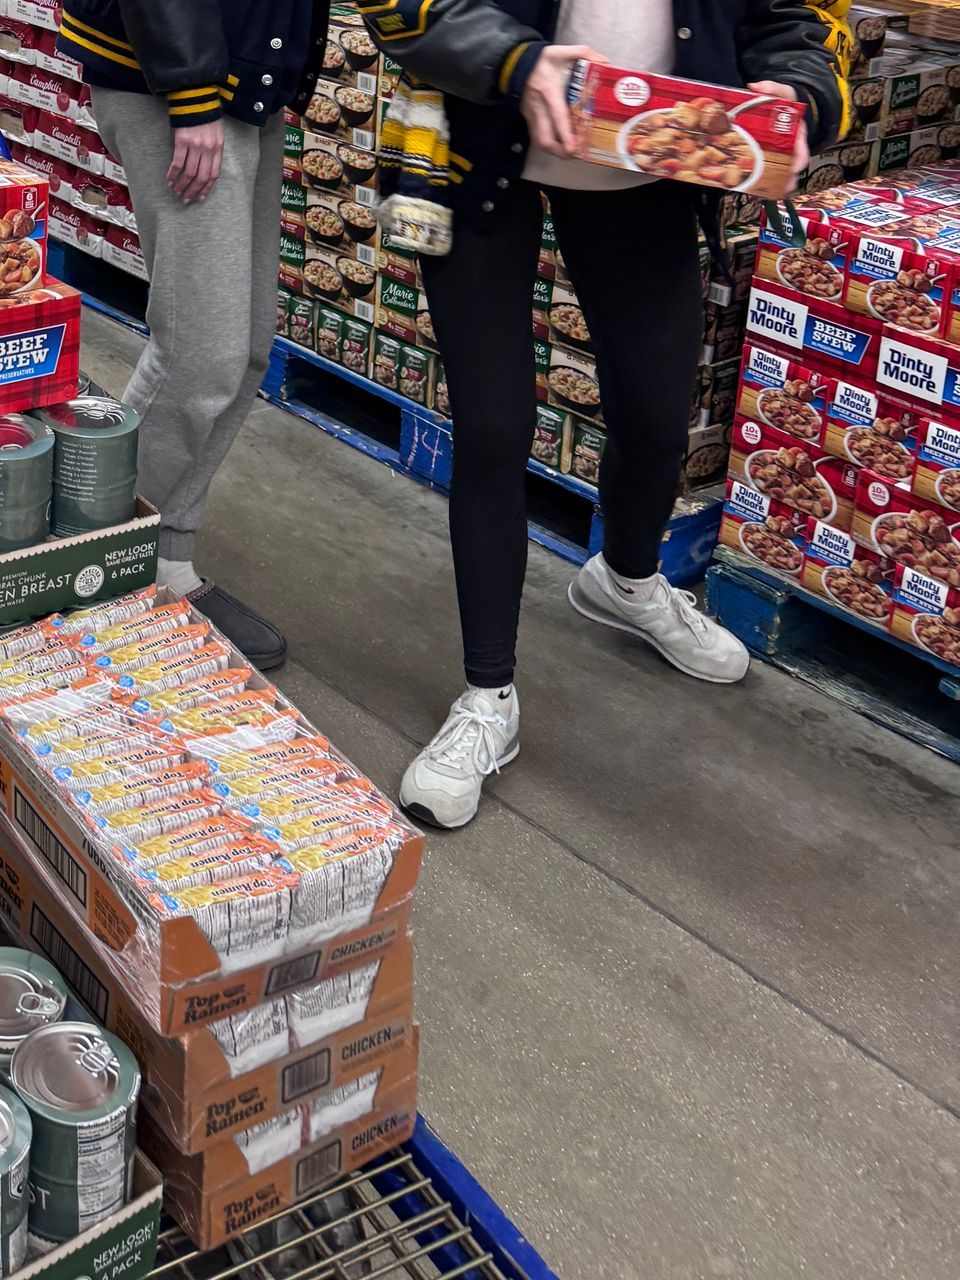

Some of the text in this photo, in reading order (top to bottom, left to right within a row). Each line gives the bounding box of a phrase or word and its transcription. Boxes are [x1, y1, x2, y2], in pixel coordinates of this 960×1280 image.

[30, 74, 62, 94] Campbell's
[52, 125, 82, 146] Campbell's
[24, 153, 54, 174] Campbell's
[52, 205, 82, 228] Campbell's
[862, 250, 896, 268] Moore
[866, 241, 895, 260] Dinty
[381, 292, 416, 311] Callender's
[382, 283, 415, 302] Marie
[755, 297, 796, 326] Dinty
[750, 309, 798, 339] Moore
[814, 320, 856, 342] BEEF
[812, 332, 856, 353] STEW
[753, 359, 783, 378] Moore
[756, 351, 782, 369] Dinty
[888, 348, 934, 379] Dinty
[0, 367, 35, 381] PRESERVATIVES
[883, 361, 937, 393] Moore
[839, 395, 872, 416] Moore
[843, 386, 871, 408] Dinty
[735, 493, 765, 514] Moore
[739, 486, 763, 505] Dinty
[817, 535, 850, 557] Moore
[822, 526, 850, 548] Dinty
[105, 541, 157, 561] NEW LOOK!
[2, 570, 28, 581] PREMIUM
[18, 572, 47, 587] CHUNK
[119, 563, 146, 578] PACK
[21, 573, 72, 598] BREAST
[906, 581, 942, 604] Moore
[911, 573, 941, 595] Dinty
[123, 777, 162, 791] Ramen
[190, 852, 229, 868] Ramen
[331, 934, 383, 962] CHICKEN
[184, 995, 247, 1025] Ramen
[342, 1027, 392, 1061] CHICKEN
[207, 1098, 237, 1120] Top
[206, 1103, 265, 1138] Ramen
[351, 1116, 398, 1151] CHICKEN
[224, 1195, 254, 1215] Top
[225, 1195, 281, 1235] Ramen
[93, 1243, 119, 1269] NEW
[112, 1250, 142, 1278] PACK
